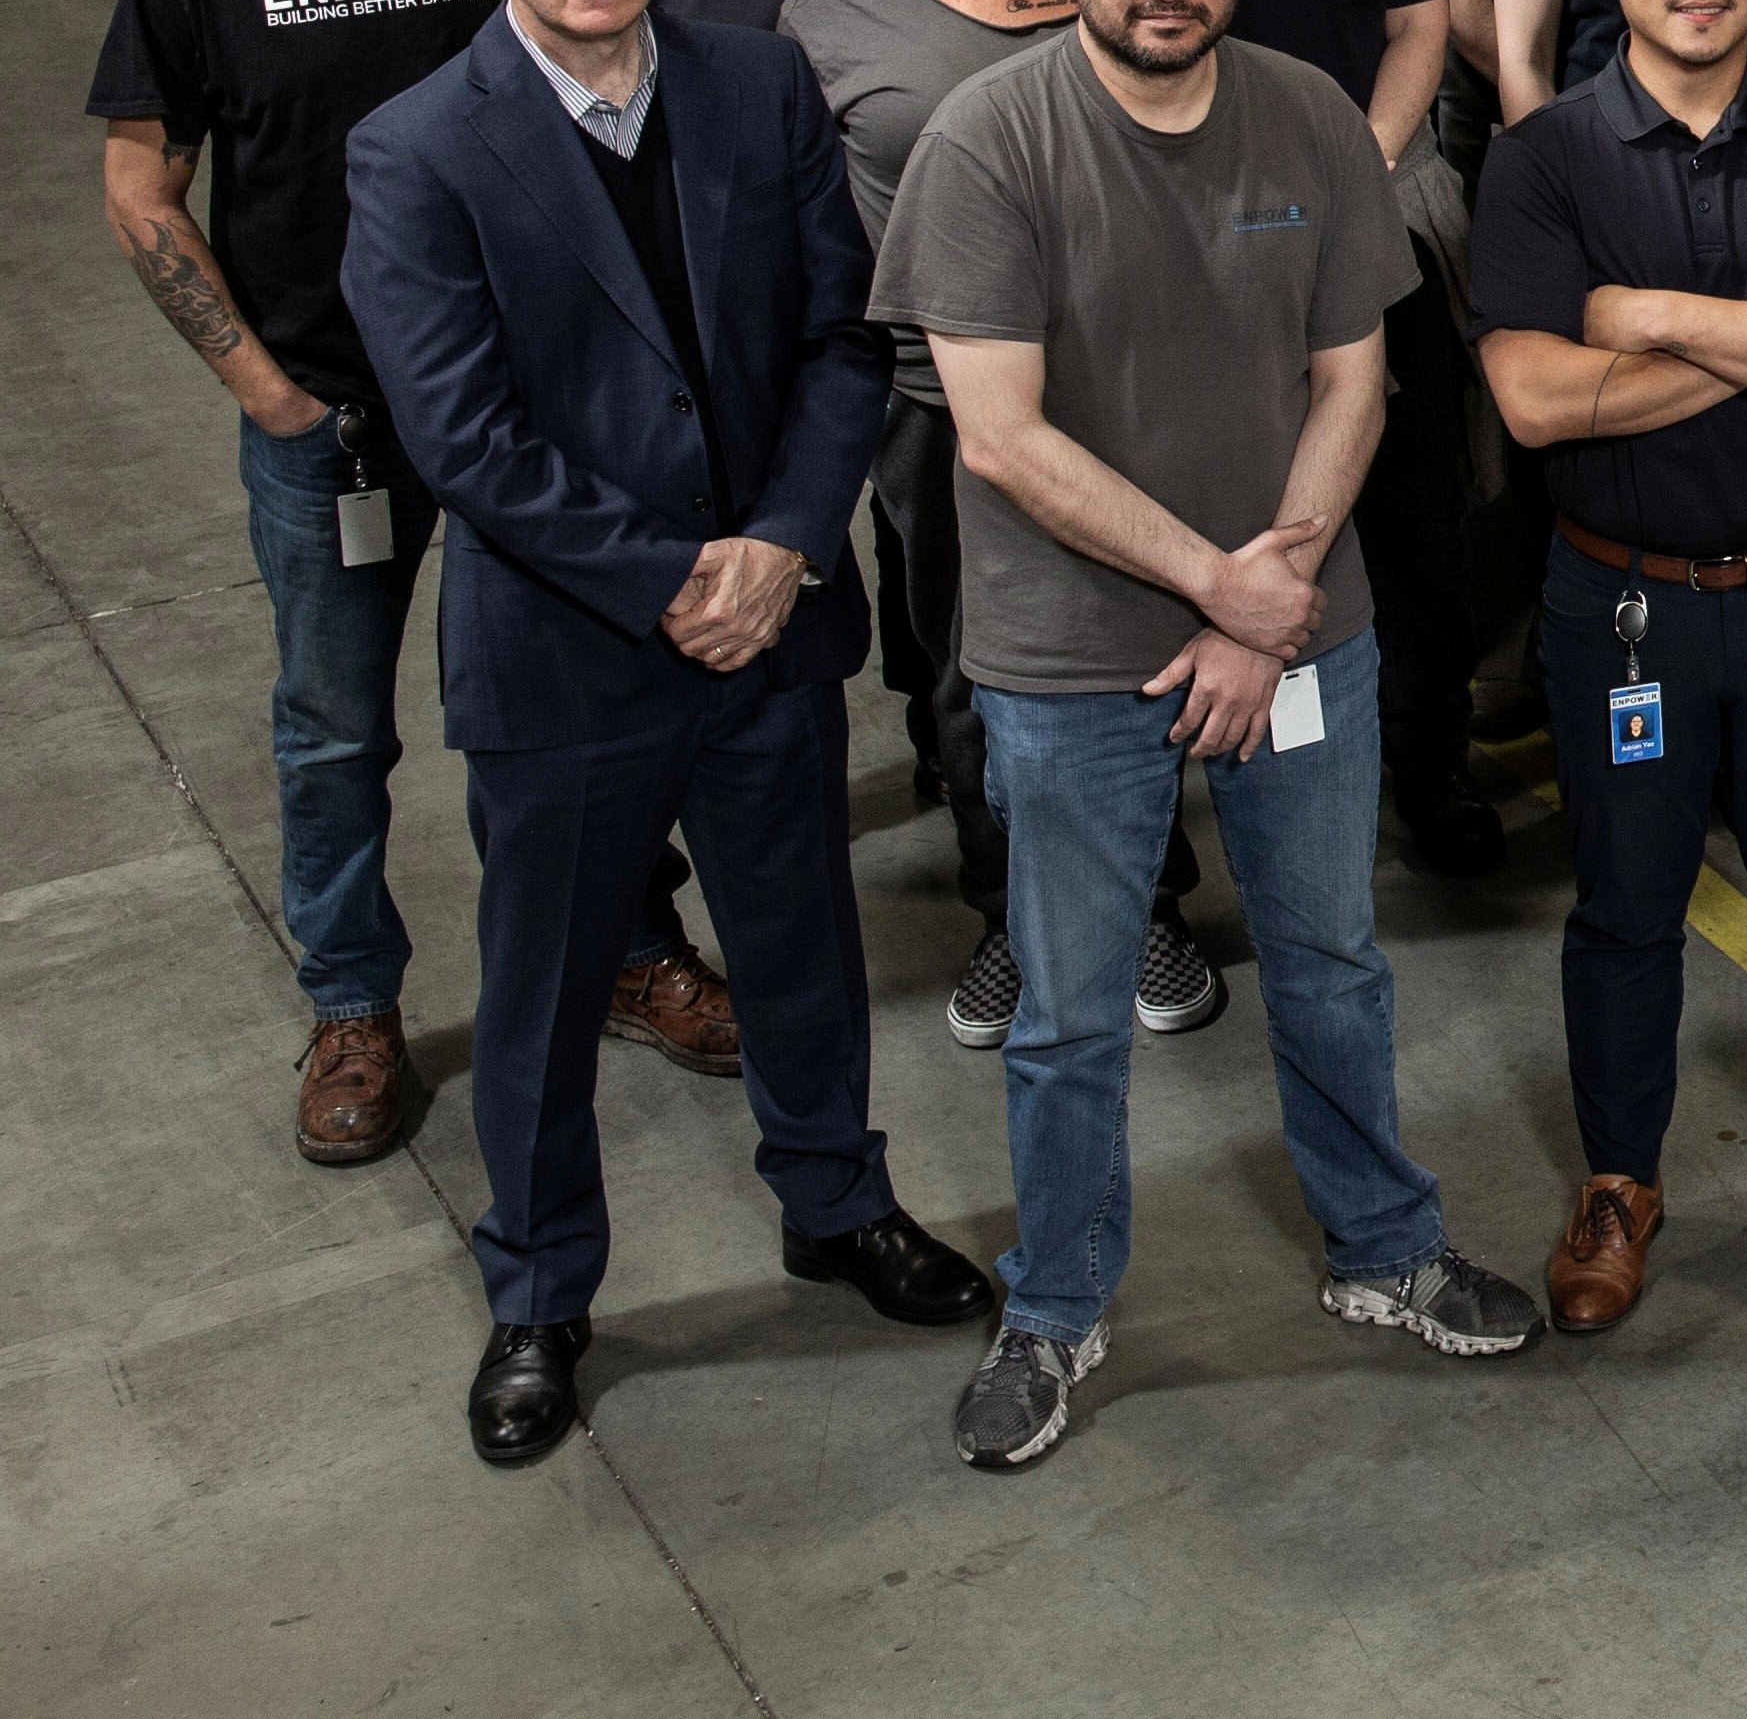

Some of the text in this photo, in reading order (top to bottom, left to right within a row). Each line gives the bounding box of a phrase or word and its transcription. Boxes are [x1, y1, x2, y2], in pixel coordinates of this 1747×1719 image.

[267, 4, 349, 26] BUILDING
[1612, 693, 1658, 707] ENPOWER
[1622, 744, 1642, 752] Adrian
